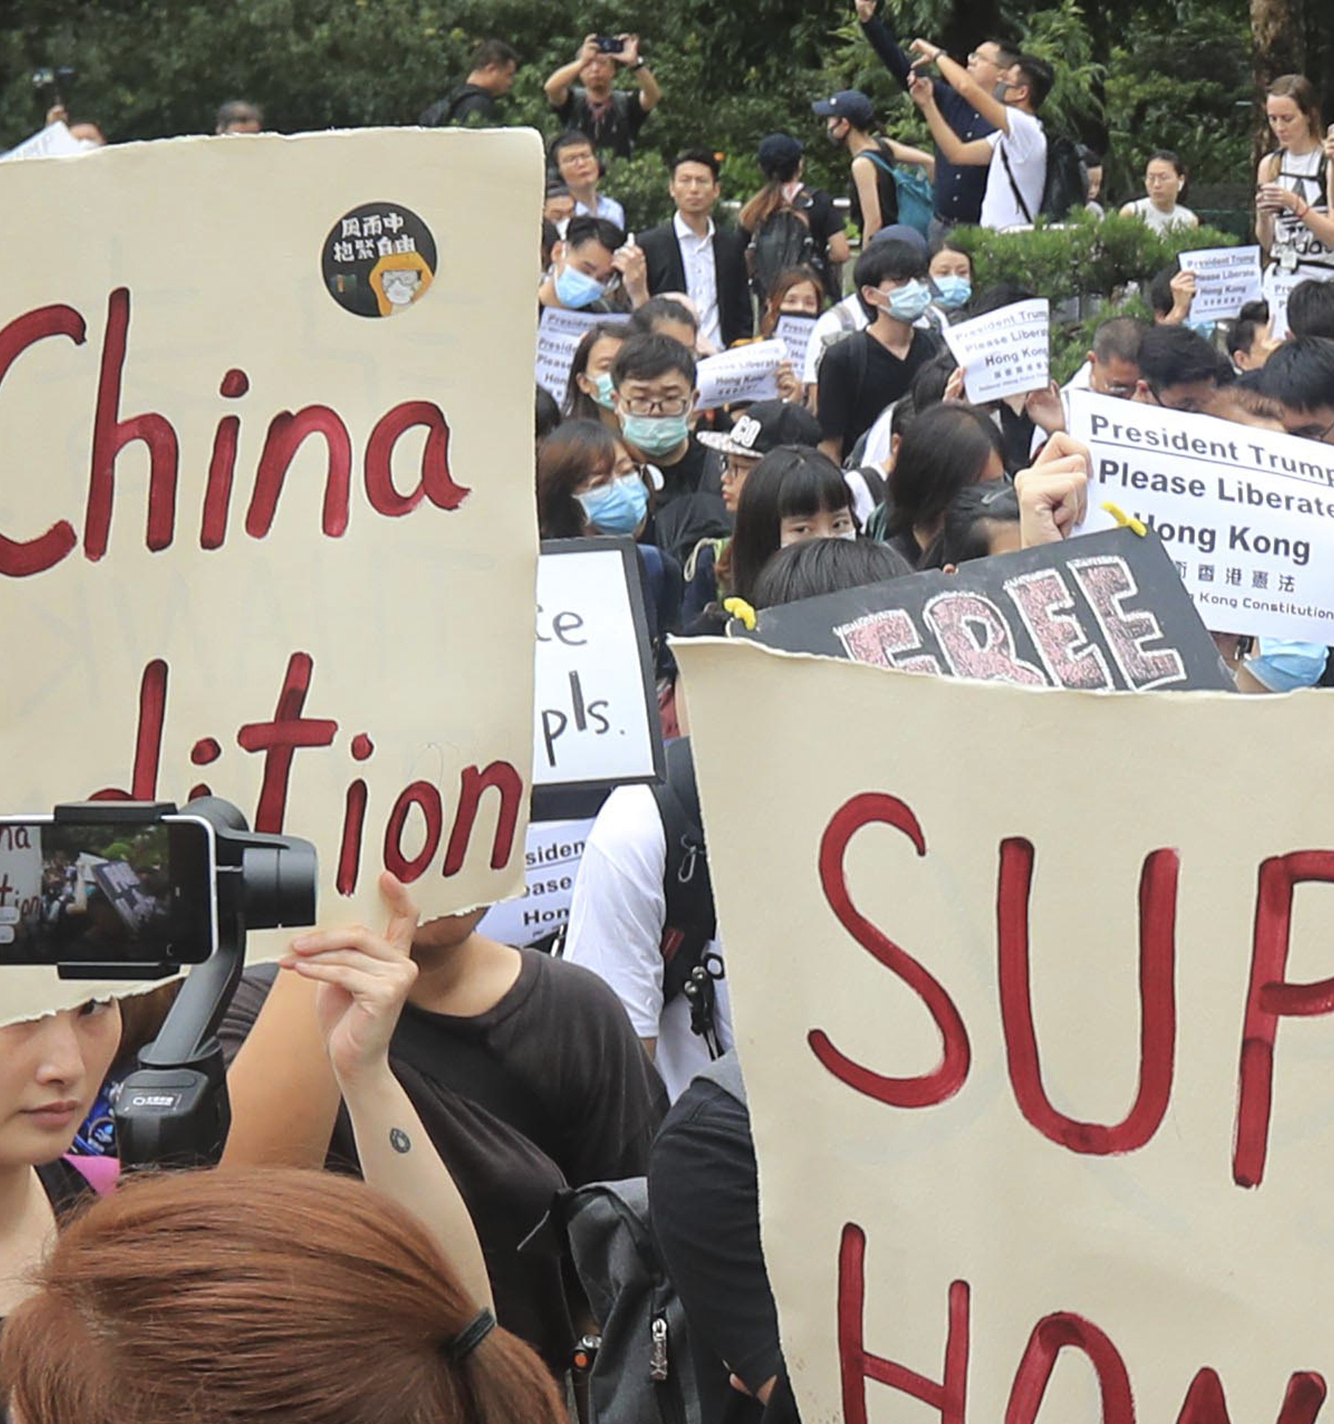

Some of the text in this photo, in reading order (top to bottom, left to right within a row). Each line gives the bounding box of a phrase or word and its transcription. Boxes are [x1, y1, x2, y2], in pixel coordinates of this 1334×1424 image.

[1018, 310, 1048, 321] Trum
[1090, 413, 1239, 461] President
[1099, 460, 1206, 497] Please
[1229, 525, 1311, 566] Kong
[832, 555, 1188, 693] FREE
[1199, 592, 1238, 609] Kong
[1242, 597, 1334, 620] Constitution
[523, 907, 569, 926] Hon
